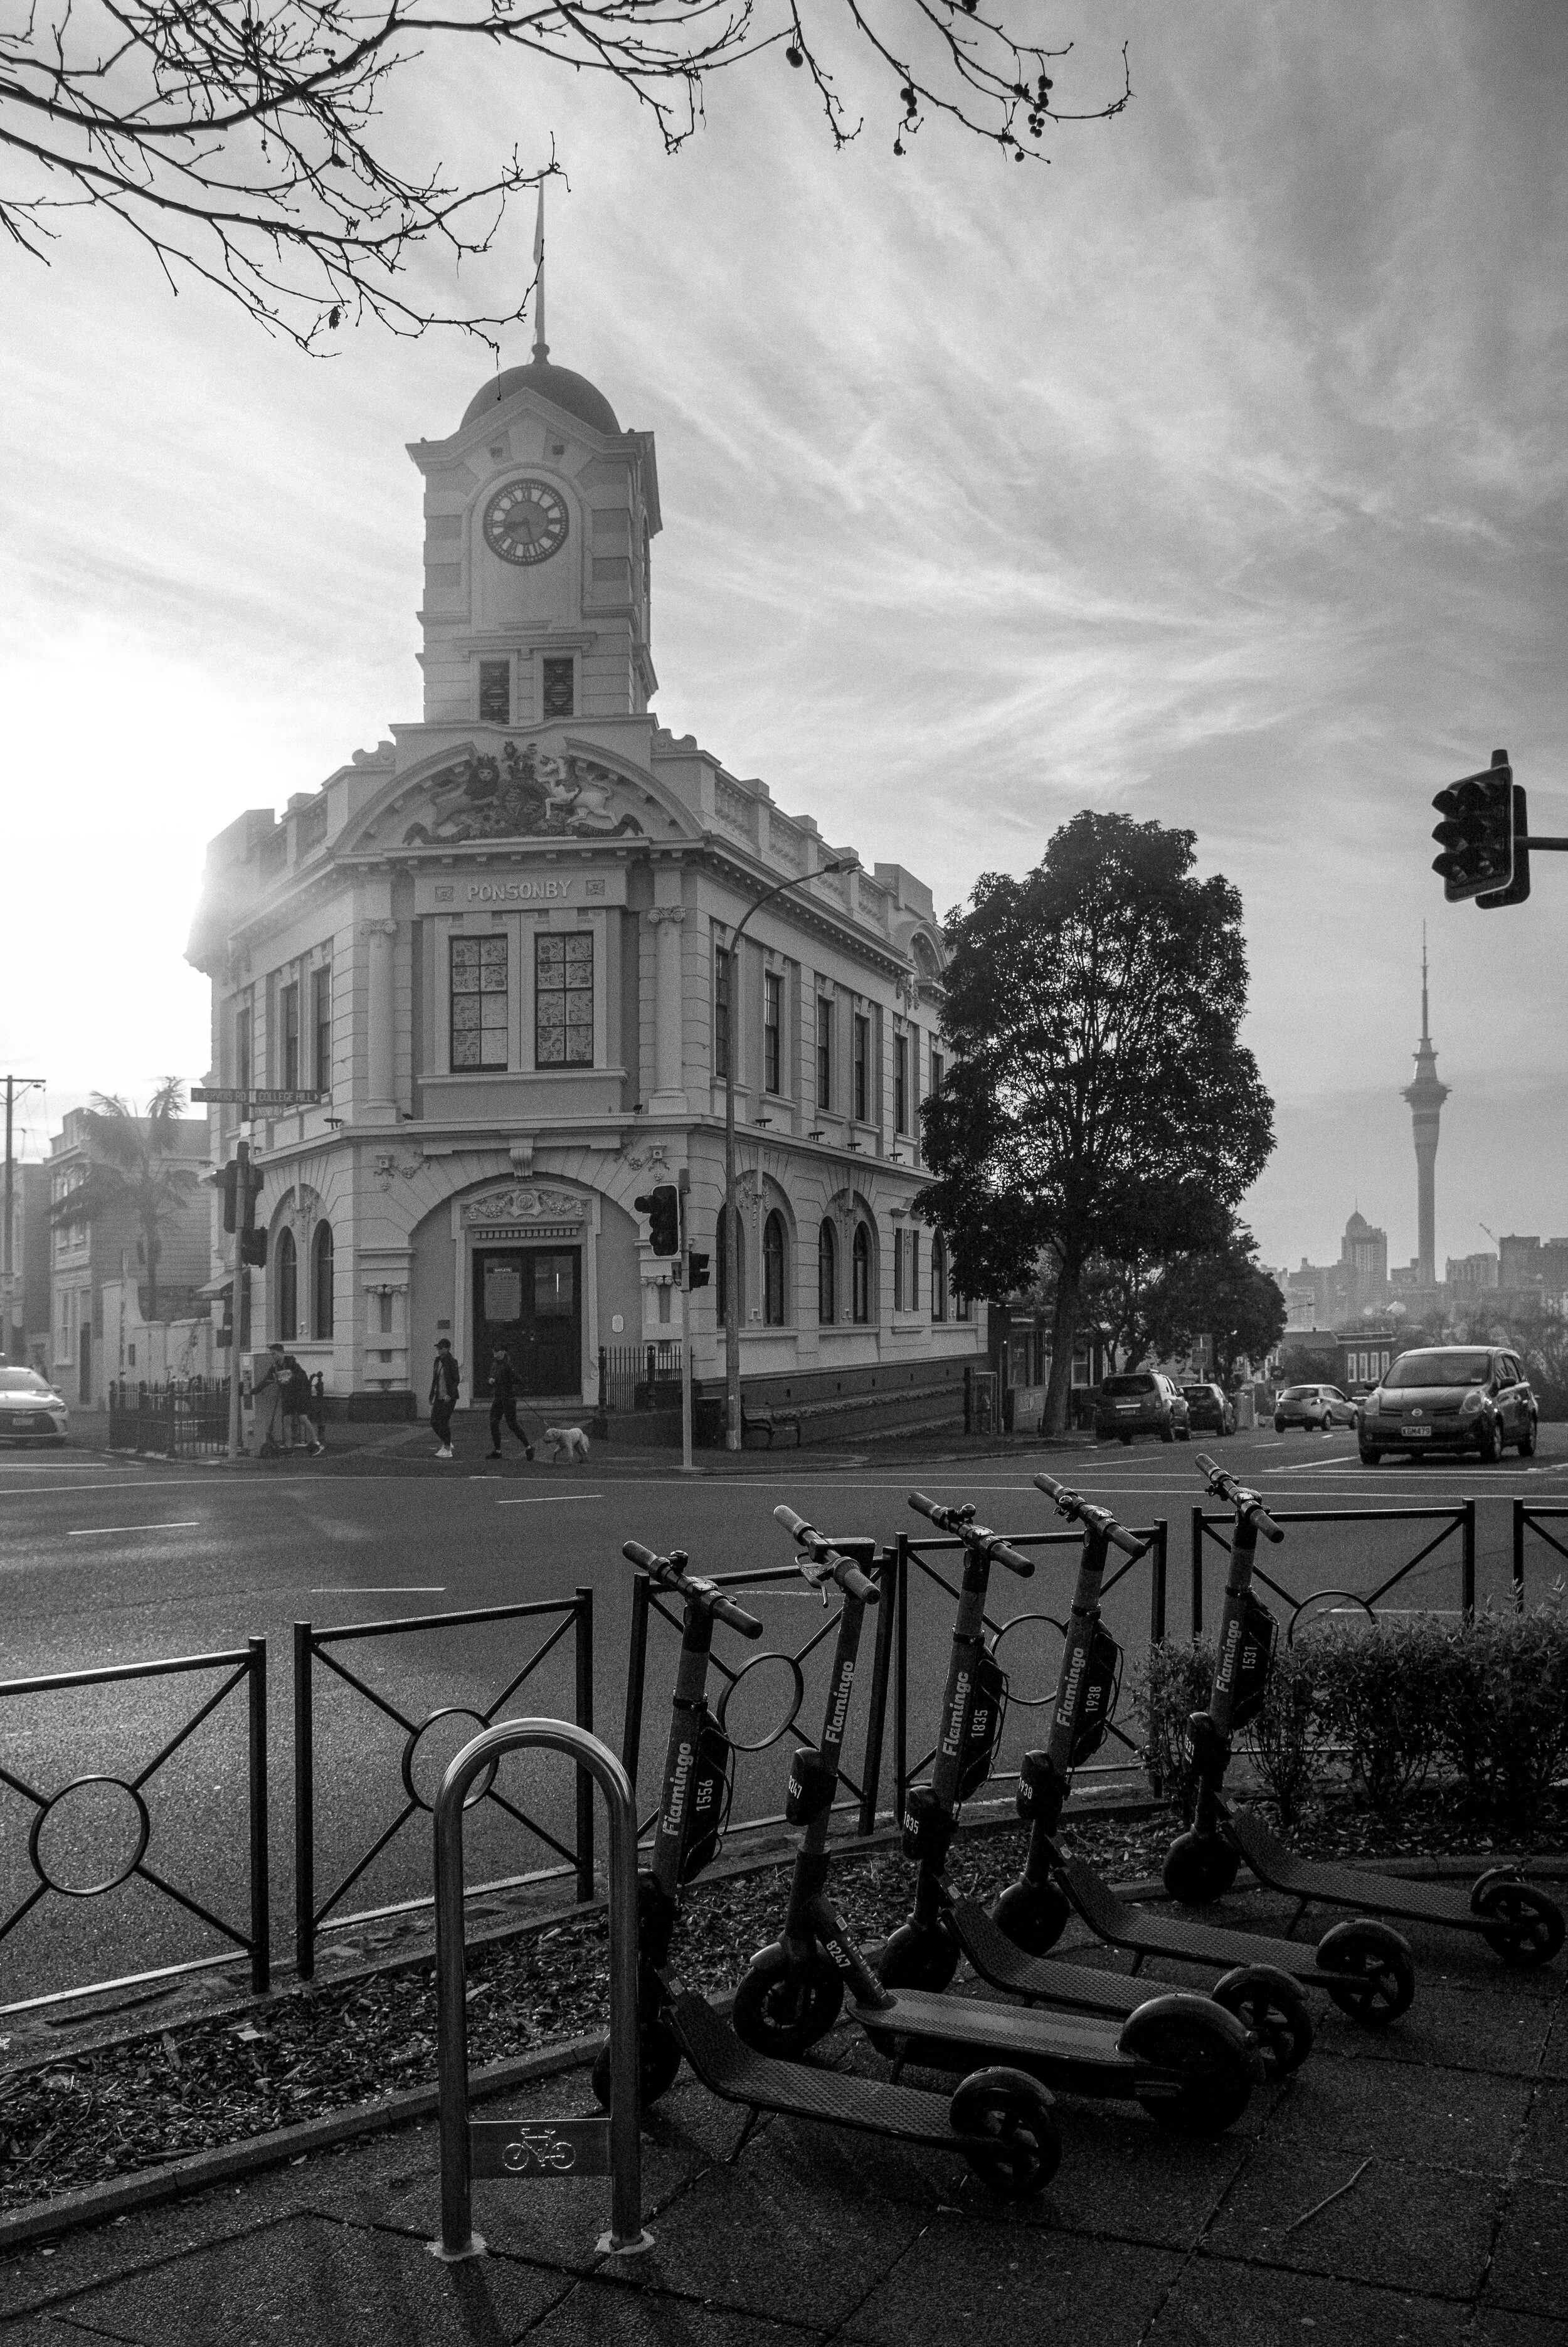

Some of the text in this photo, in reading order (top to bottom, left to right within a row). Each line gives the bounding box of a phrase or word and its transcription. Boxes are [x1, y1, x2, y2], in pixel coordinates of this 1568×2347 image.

[467, 880, 572, 901] PONSONBY
[201, 1090, 247, 1101] JERVOIS RD
[258, 1091, 312, 1103] COLLEGE HILL
[1216, 1619, 1242, 1693] Flamingo
[1242, 1645, 1258, 1670] 1531
[1056, 1647, 1086, 1727] Flamingo
[1085, 1685, 1102, 1714] 1938
[825, 1661, 854, 1744] Flamingo
[970, 1709, 988, 1738] 1835
[662, 1742, 694, 1836] Flamingo
[696, 1779, 714, 1812] 1556
[1018, 1777, 1034, 1800] 1938
[903, 1810, 919, 1835] 1835
[826, 1940, 851, 1968] 8247
